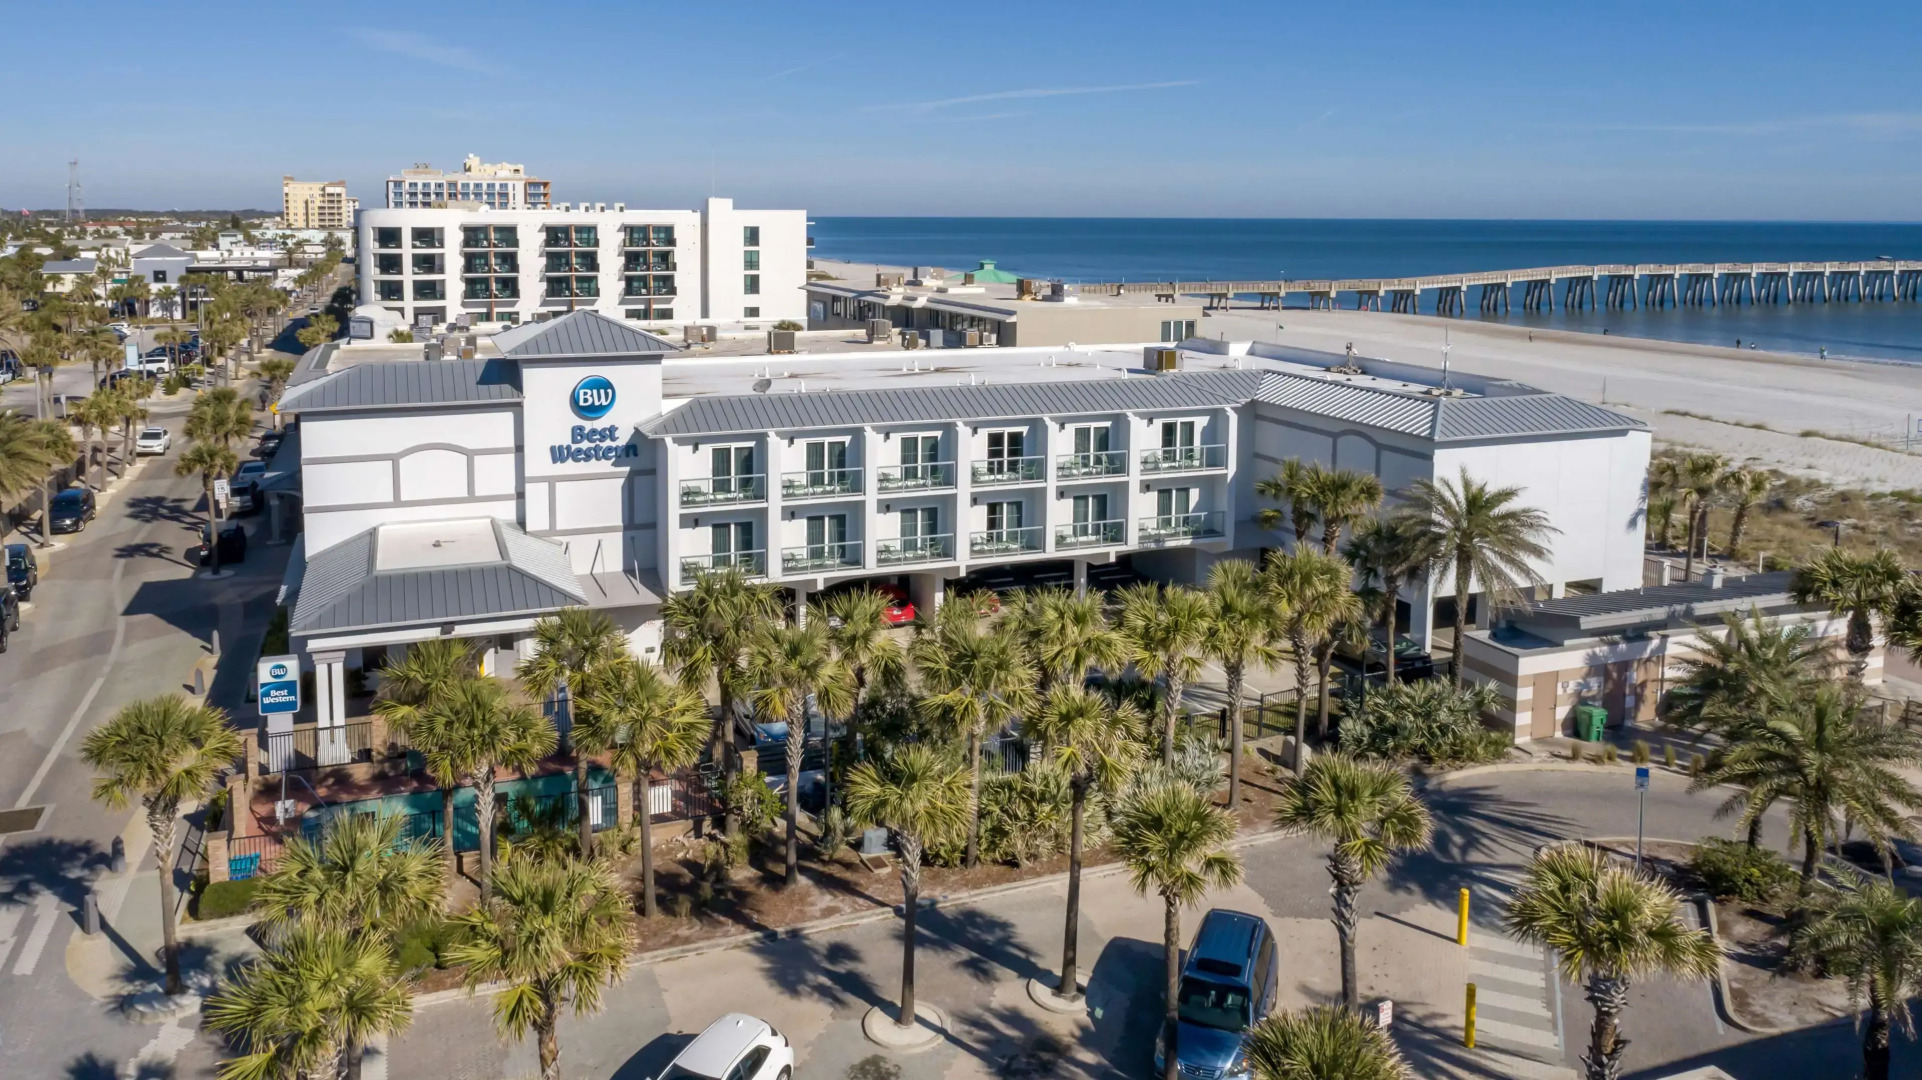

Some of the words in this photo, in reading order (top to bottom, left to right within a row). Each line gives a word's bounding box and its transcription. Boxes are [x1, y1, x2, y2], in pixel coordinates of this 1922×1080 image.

[579, 389, 612, 406] BW
[571, 425, 619, 444] Best
[550, 444, 638, 464] Western
[271, 668, 286, 676] BW
[270, 689, 288, 697] Best
[263, 696, 295, 704] Western
